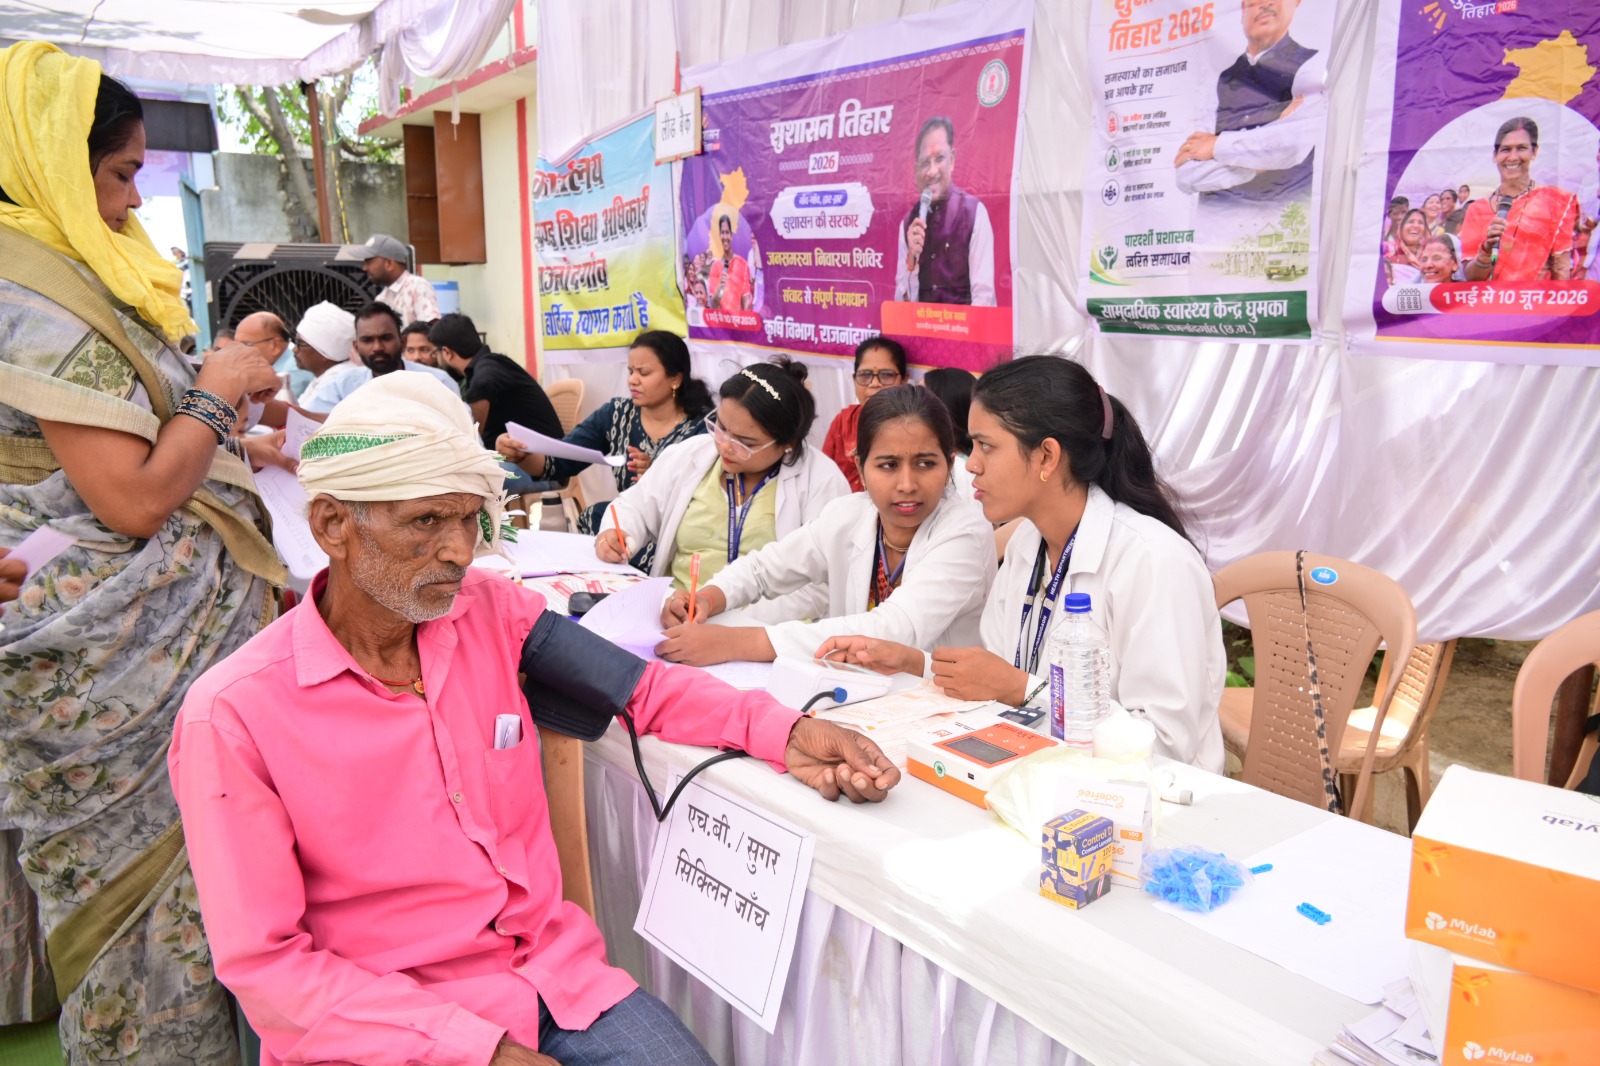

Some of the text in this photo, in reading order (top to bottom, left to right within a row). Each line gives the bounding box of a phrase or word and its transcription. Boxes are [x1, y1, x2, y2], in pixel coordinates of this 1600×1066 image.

[1462, 2, 1496, 19] तिहार
[1109, 18, 1163, 52] तिहार
[1168, 3, 1214, 41] 2026
[1142, 68, 1154, 78] का
[1155, 61, 1188, 77] समाधान
[1116, 83, 1138, 97] आपके
[769, 98, 894, 154] सुशासन तिहार
[811, 156, 835, 171] 2026
[555, 209, 599, 249] शिक्षा
[602, 185, 650, 241] अधिकारी
[782, 211, 859, 233] सुशासन की सरकार
[1125, 229, 1195, 247] पारदर्शी प्रशासन
[766, 247, 883, 268] जनसमस्या निवारण शिविर
[1150, 252, 1191, 266] समाधान
[782, 286, 868, 309] संवाद से संपूर्ण समाधान
[1443, 285, 1588, 310] 1 मई से 10 जून 2026
[1101, 297, 1288, 323] सामुदायिक स्वास्थ्य केन्द्र घुमका
[763, 315, 784, 343] कृषि
[785, 316, 818, 345] विभाग,
[1050, 537, 1076, 596] HEALTH DEPARTMENT
[1078, 789, 1125, 804] CodeFree
[1542, 815, 1600, 833] ylab
[688, 804, 732, 848] एच.बी.
[746, 836, 781, 875] सुगर
[1081, 829, 1107, 848] Control
[1081, 843, 1099, 856] Comfort
[675, 848, 770, 932] सिक्लिन जाँच
[1450, 918, 1496, 939] Mylab
[1487, 1047, 1534, 1063] Mylab
